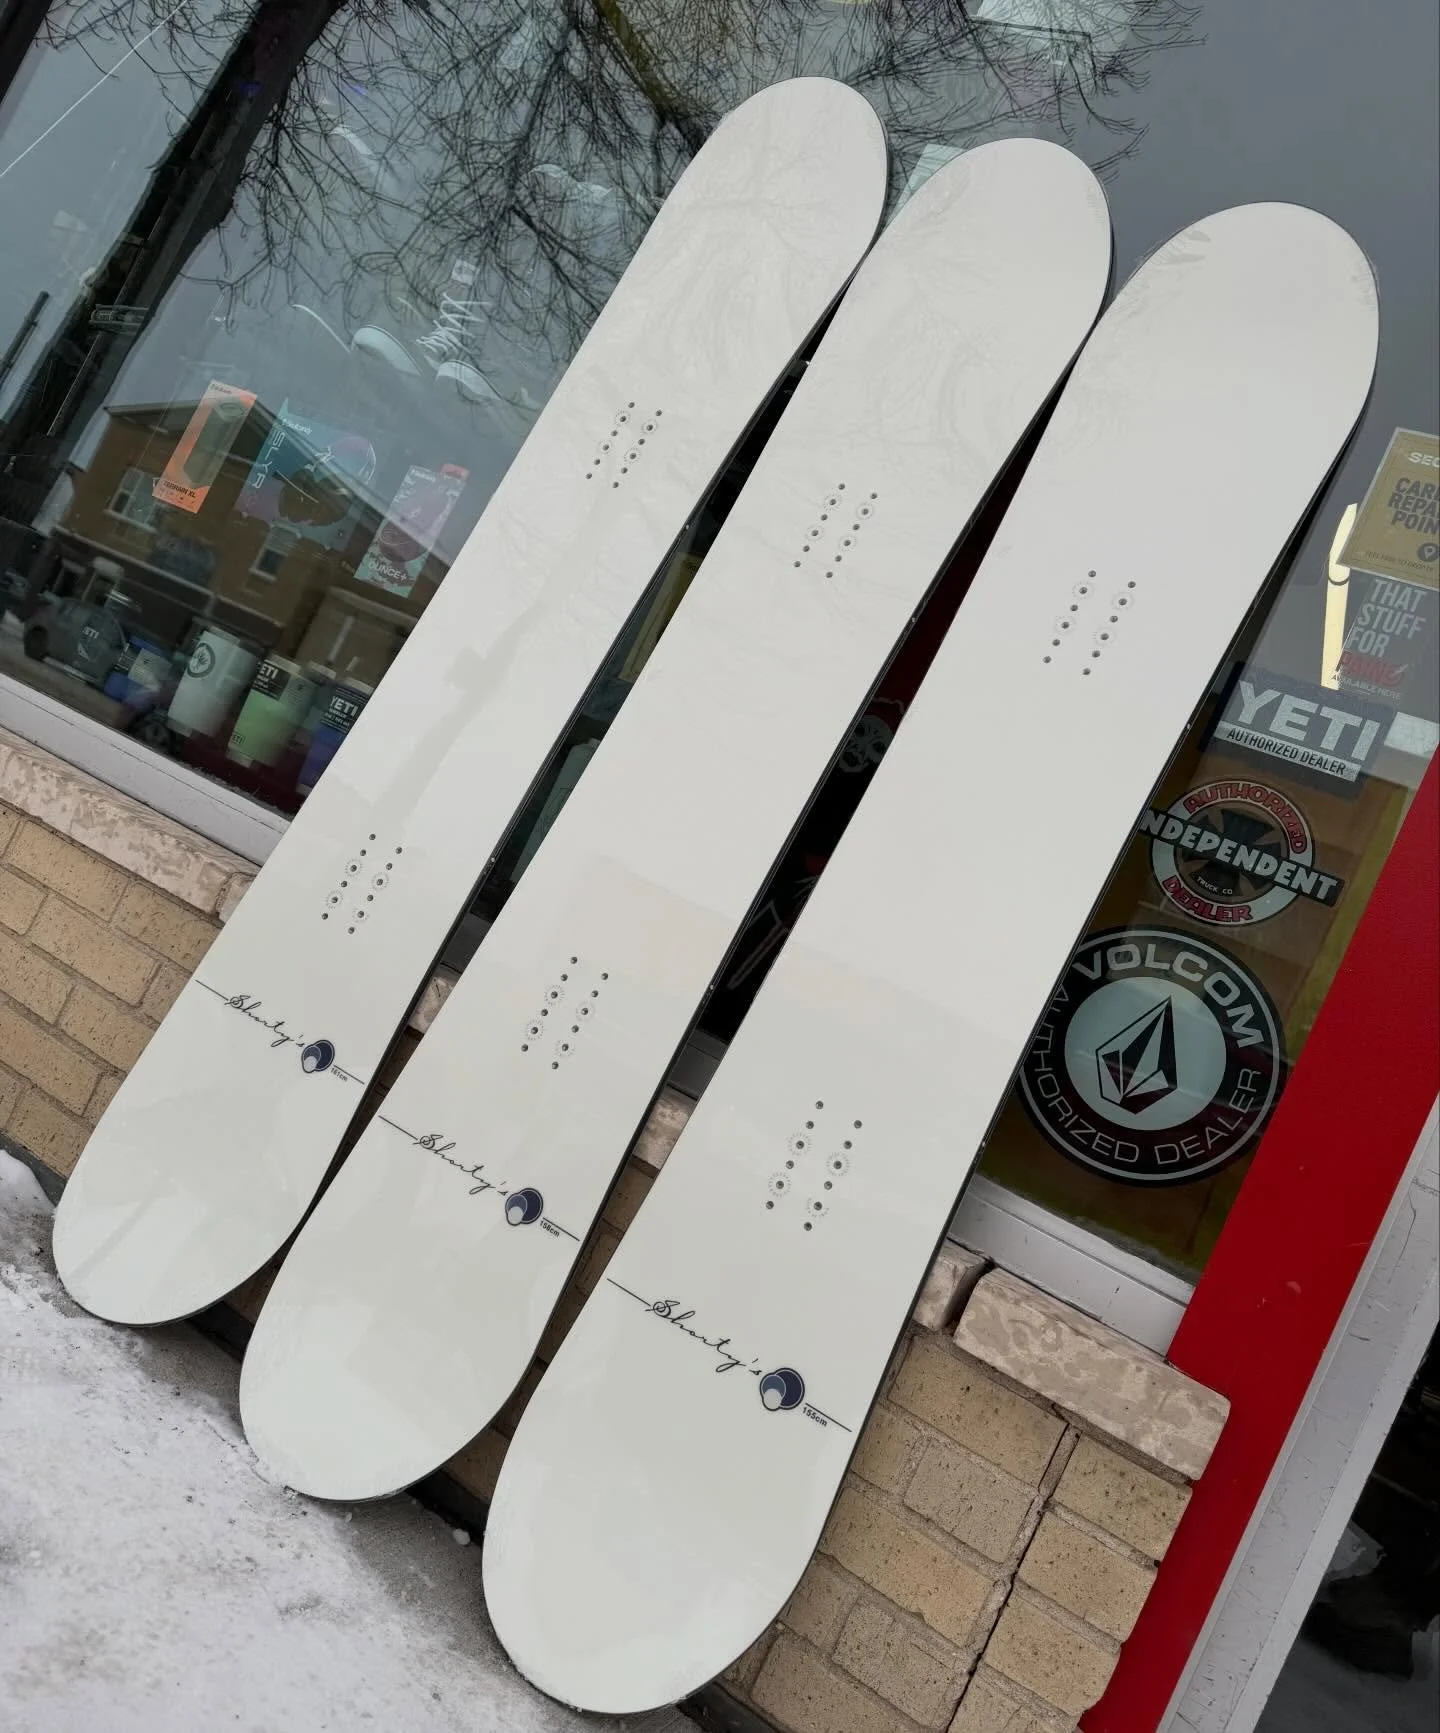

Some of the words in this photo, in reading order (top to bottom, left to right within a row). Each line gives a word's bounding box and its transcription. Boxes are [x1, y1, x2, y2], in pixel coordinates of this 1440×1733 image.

[1388, 491, 1439, 517] REPA
[1369, 579, 1428, 612] THAT
[1343, 626, 1390, 657] FOR
[1357, 603, 1427, 639] STUFF
[258, 661, 279, 679] ETI
[1238, 680, 1380, 760] YETI
[1227, 727, 1300, 759] AUTHORIZED
[1300, 751, 1346, 775] DEALER
[1183, 782, 1308, 854] AUTHORIZED
[1138, 809, 1338, 900] NDEPENDENT
[1162, 875, 1254, 922] DEALER
[1196, 876, 1219, 894] TRUCK
[1222, 887, 1233, 895] CO
[1071, 943, 1265, 1048] VOLCOM
[224, 994, 305, 1048] Shorty's
[1154, 1067, 1262, 1164] DEALER
[412, 1133, 508, 1195] Shorty's
[645, 1300, 762, 1375] Shorty's
[802, 1406, 828, 1427] 155cm
